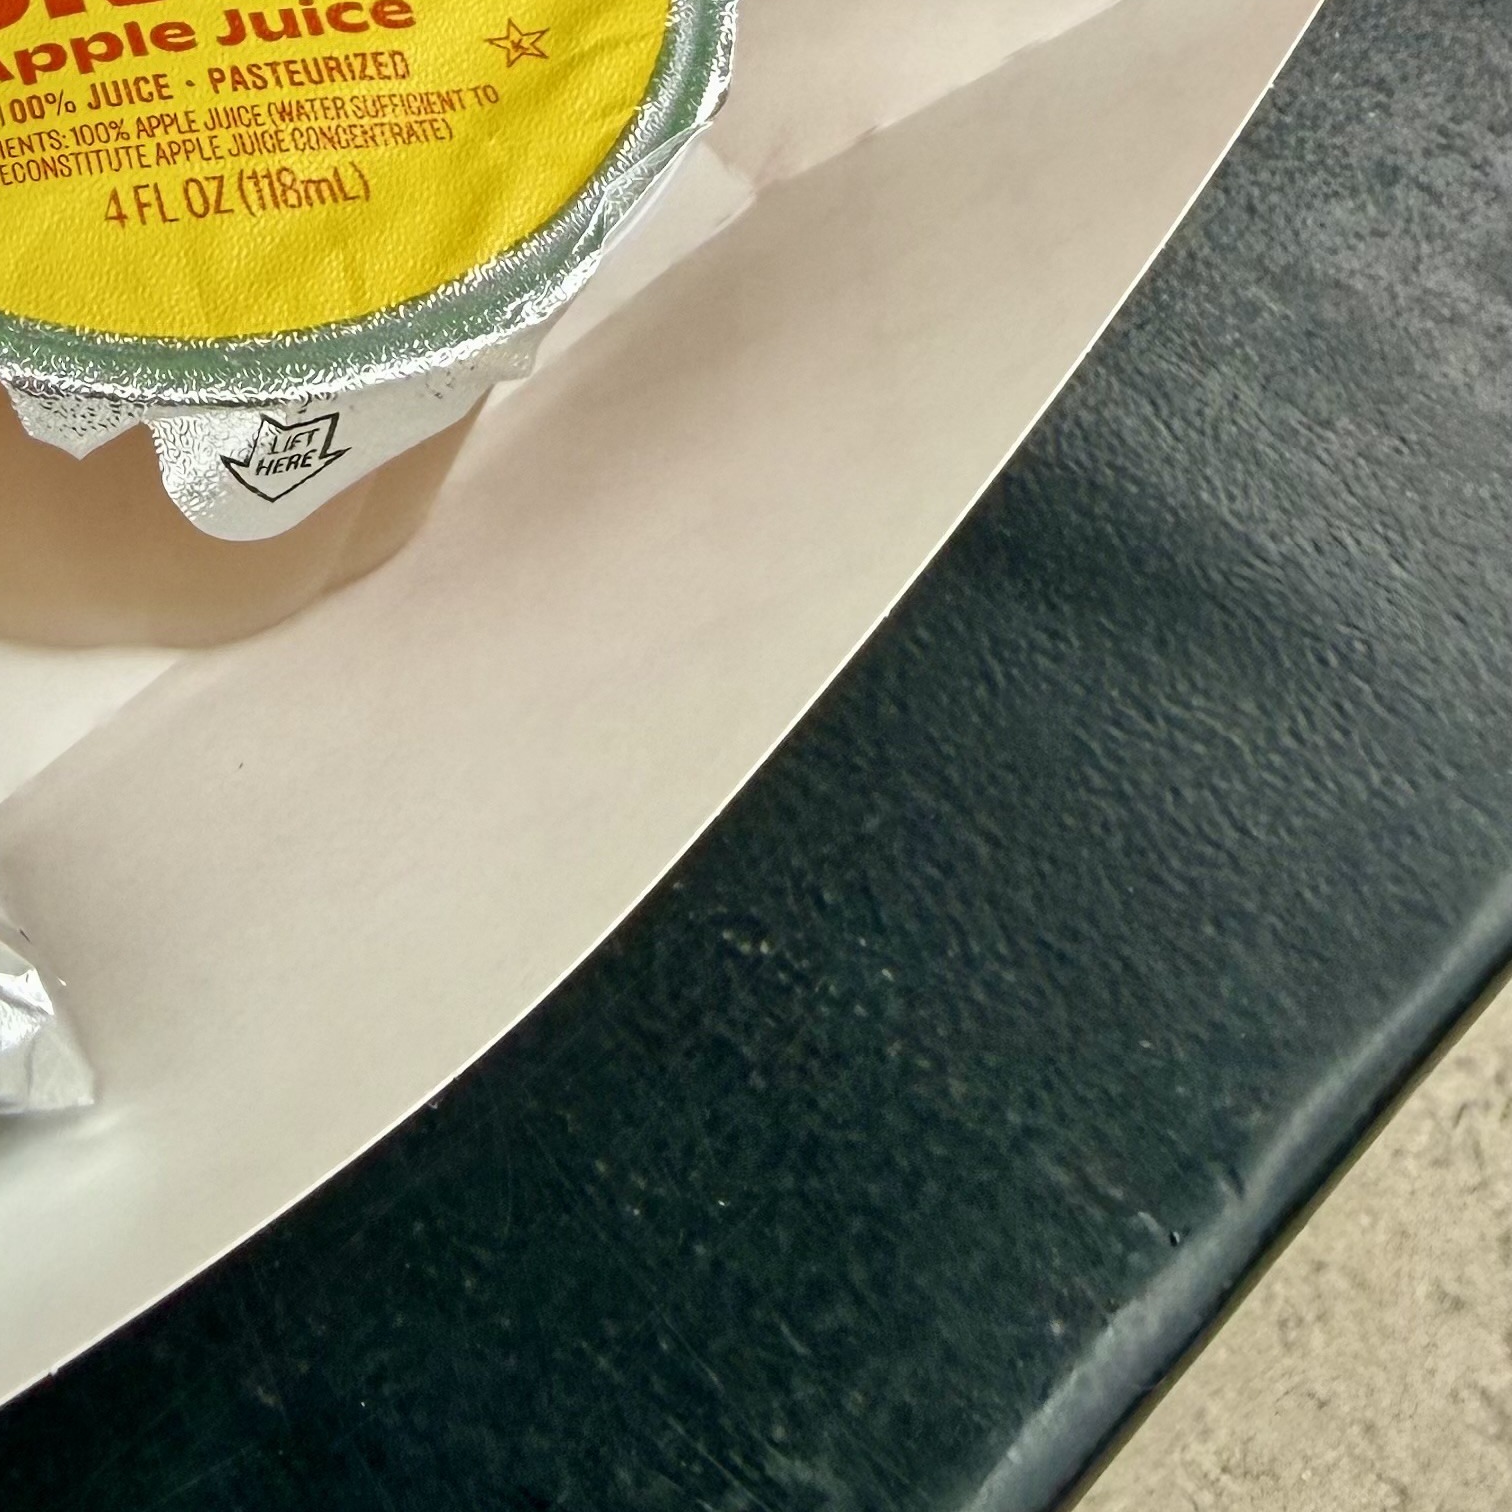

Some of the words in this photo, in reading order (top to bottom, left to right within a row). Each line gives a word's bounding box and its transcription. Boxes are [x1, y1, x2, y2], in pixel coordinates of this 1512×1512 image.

[87, 73, 174, 111] JUICE
[207, 50, 411, 95] PASTEURIZED
[69, 118, 131, 148] 100%
[135, 110, 198, 140] APPLE
[203, 103, 266, 134] JUICE
[267, 95, 347, 128] (WATER
[350, 88, 468, 122] SUFFICIENT
[470, 83, 500, 109] TO
[154, 134, 225, 167] APPLE
[227, 126, 291, 157] JUICE
[294, 117, 454, 153] CONCENTRATE)
[104, 186, 128, 229] 4
[133, 181, 180, 226] FL
[183, 172, 234, 219] OZ
[238, 161, 371, 218] (118mL)
[254, 448, 314, 476] HERE
[267, 427, 320, 456] LIFT
